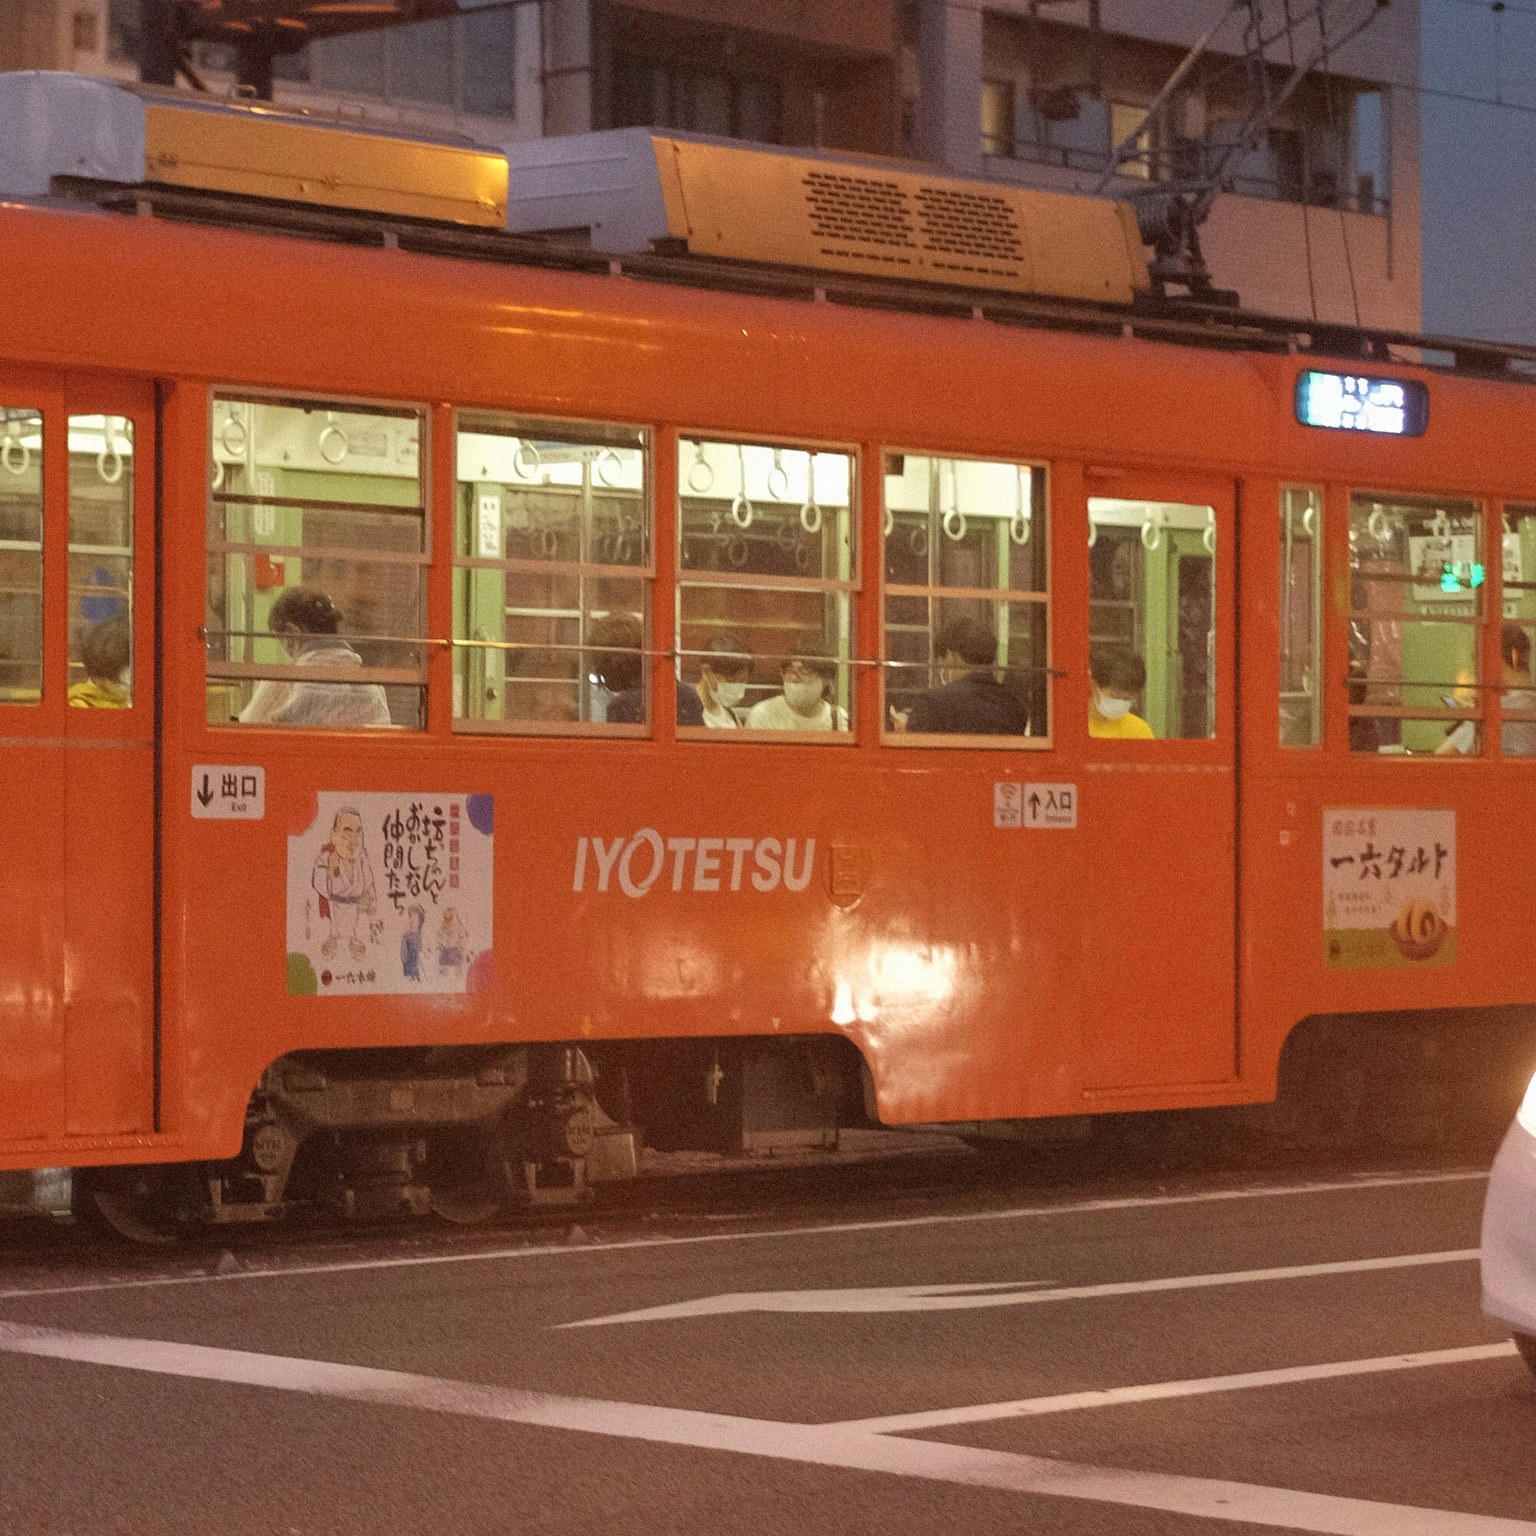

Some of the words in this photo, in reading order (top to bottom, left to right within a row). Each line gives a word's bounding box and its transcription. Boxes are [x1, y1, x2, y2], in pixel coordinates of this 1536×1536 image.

[221, 773, 257, 799] 出口
[1045, 790, 1072, 810] 入口
[381, 808, 407, 912] 仲間たち
[405, 802, 423, 897] おかしな
[572, 827, 815, 898] IYOTETSU
[1330, 842, 1448, 880] 一六タルト
